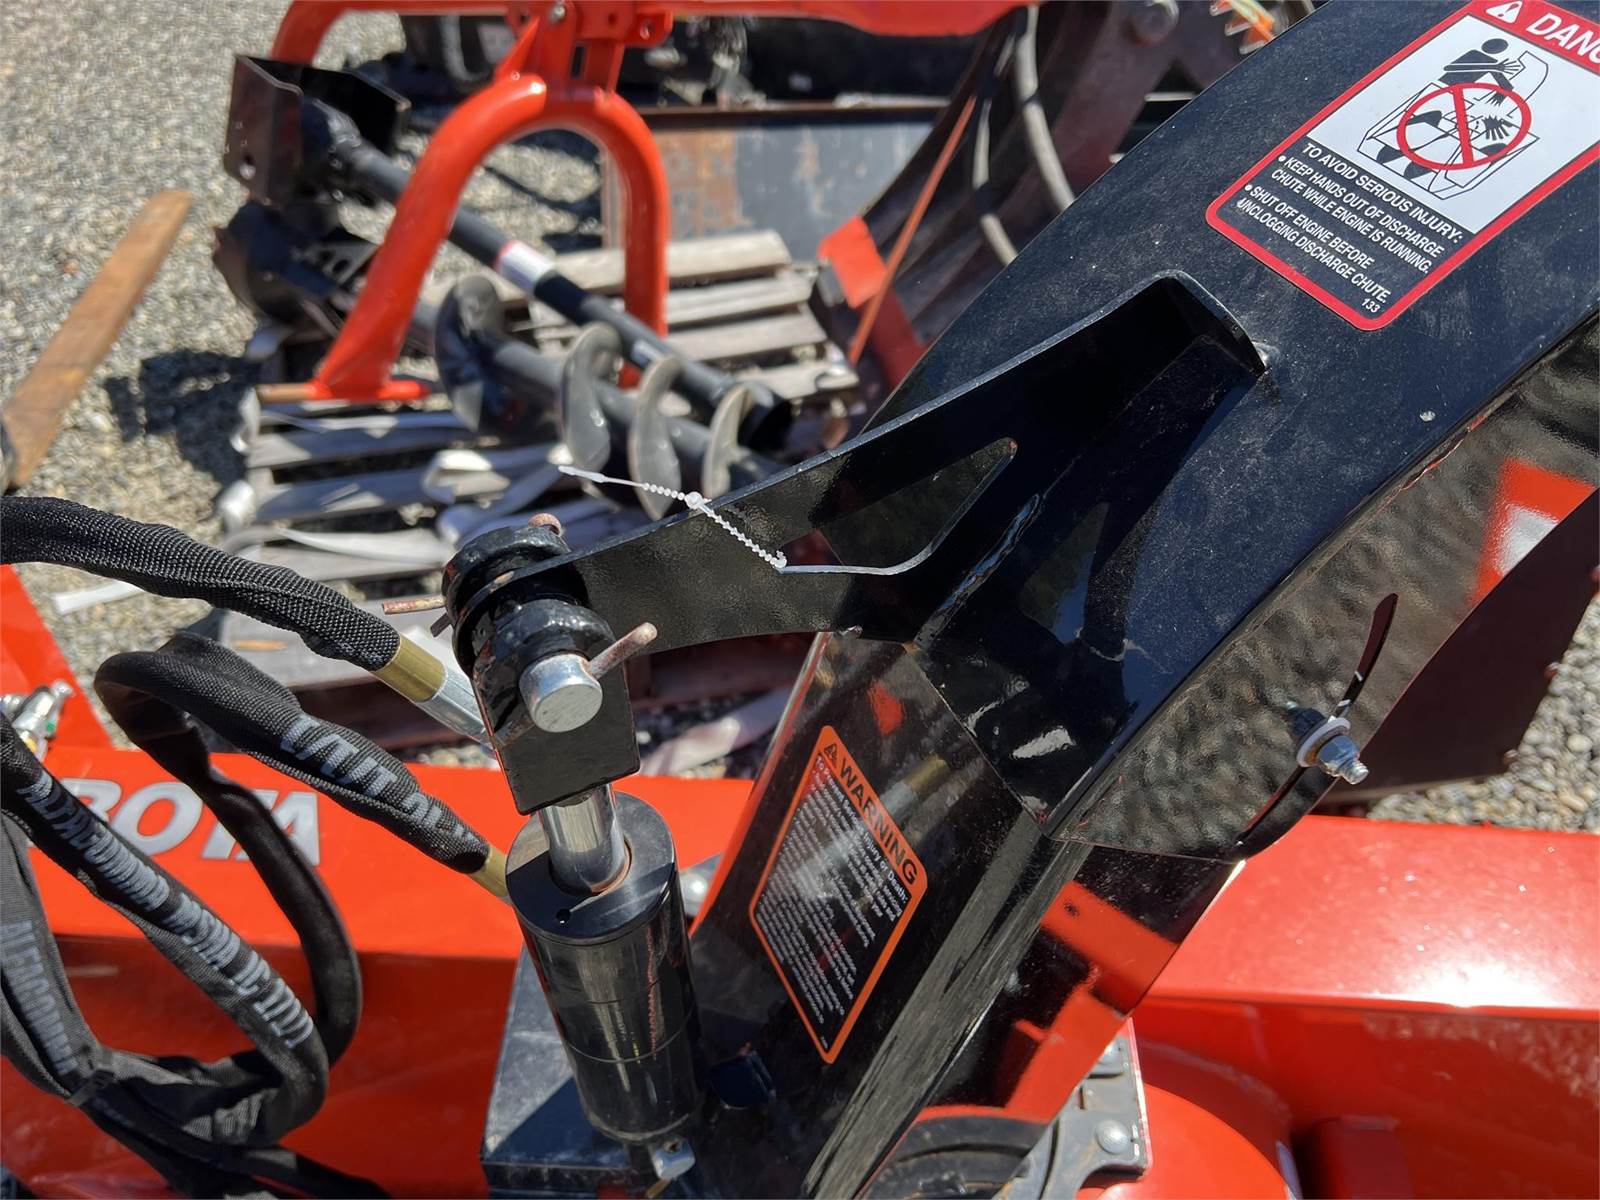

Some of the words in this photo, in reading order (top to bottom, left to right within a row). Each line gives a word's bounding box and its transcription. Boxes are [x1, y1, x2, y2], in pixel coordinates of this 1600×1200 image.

[1249, 185, 1280, 207] SHUT
[1274, 201, 1299, 219] OFF
[1292, 213, 1335, 244] ENGINE
[1327, 236, 1375, 270] BEFORE
[1271, 168, 1308, 194] CHUTE
[1302, 186, 1338, 213] WHILE
[1331, 205, 1375, 236] ENGINE
[1367, 228, 1385, 242] IS
[1379, 235, 1433, 274] RUNNING.
[1283, 156, 1314, 177] KEEP
[1308, 171, 1347, 198] HANDS
[1342, 192, 1370, 211] OUT
[1364, 205, 1385, 219] OF
[1378, 214, 1445, 258] DISCHARGE
[1302, 142, 1323, 159] TO
[1317, 154, 1359, 180] AVOID
[1355, 174, 1414, 213] SERIOUS
[1408, 206, 1463, 244] INJURY:
[1236, 197, 1300, 243] UNCLOGGING
[1294, 235, 1357, 279] DISCHARGE
[1350, 272, 1392, 304] CHUTE.
[1361, 298, 1381, 313] 133
[837, 757, 919, 887] WARNING
[862, 830, 881, 864] Injury
[879, 858, 888, 874] or
[887, 868, 909, 905] Death:
